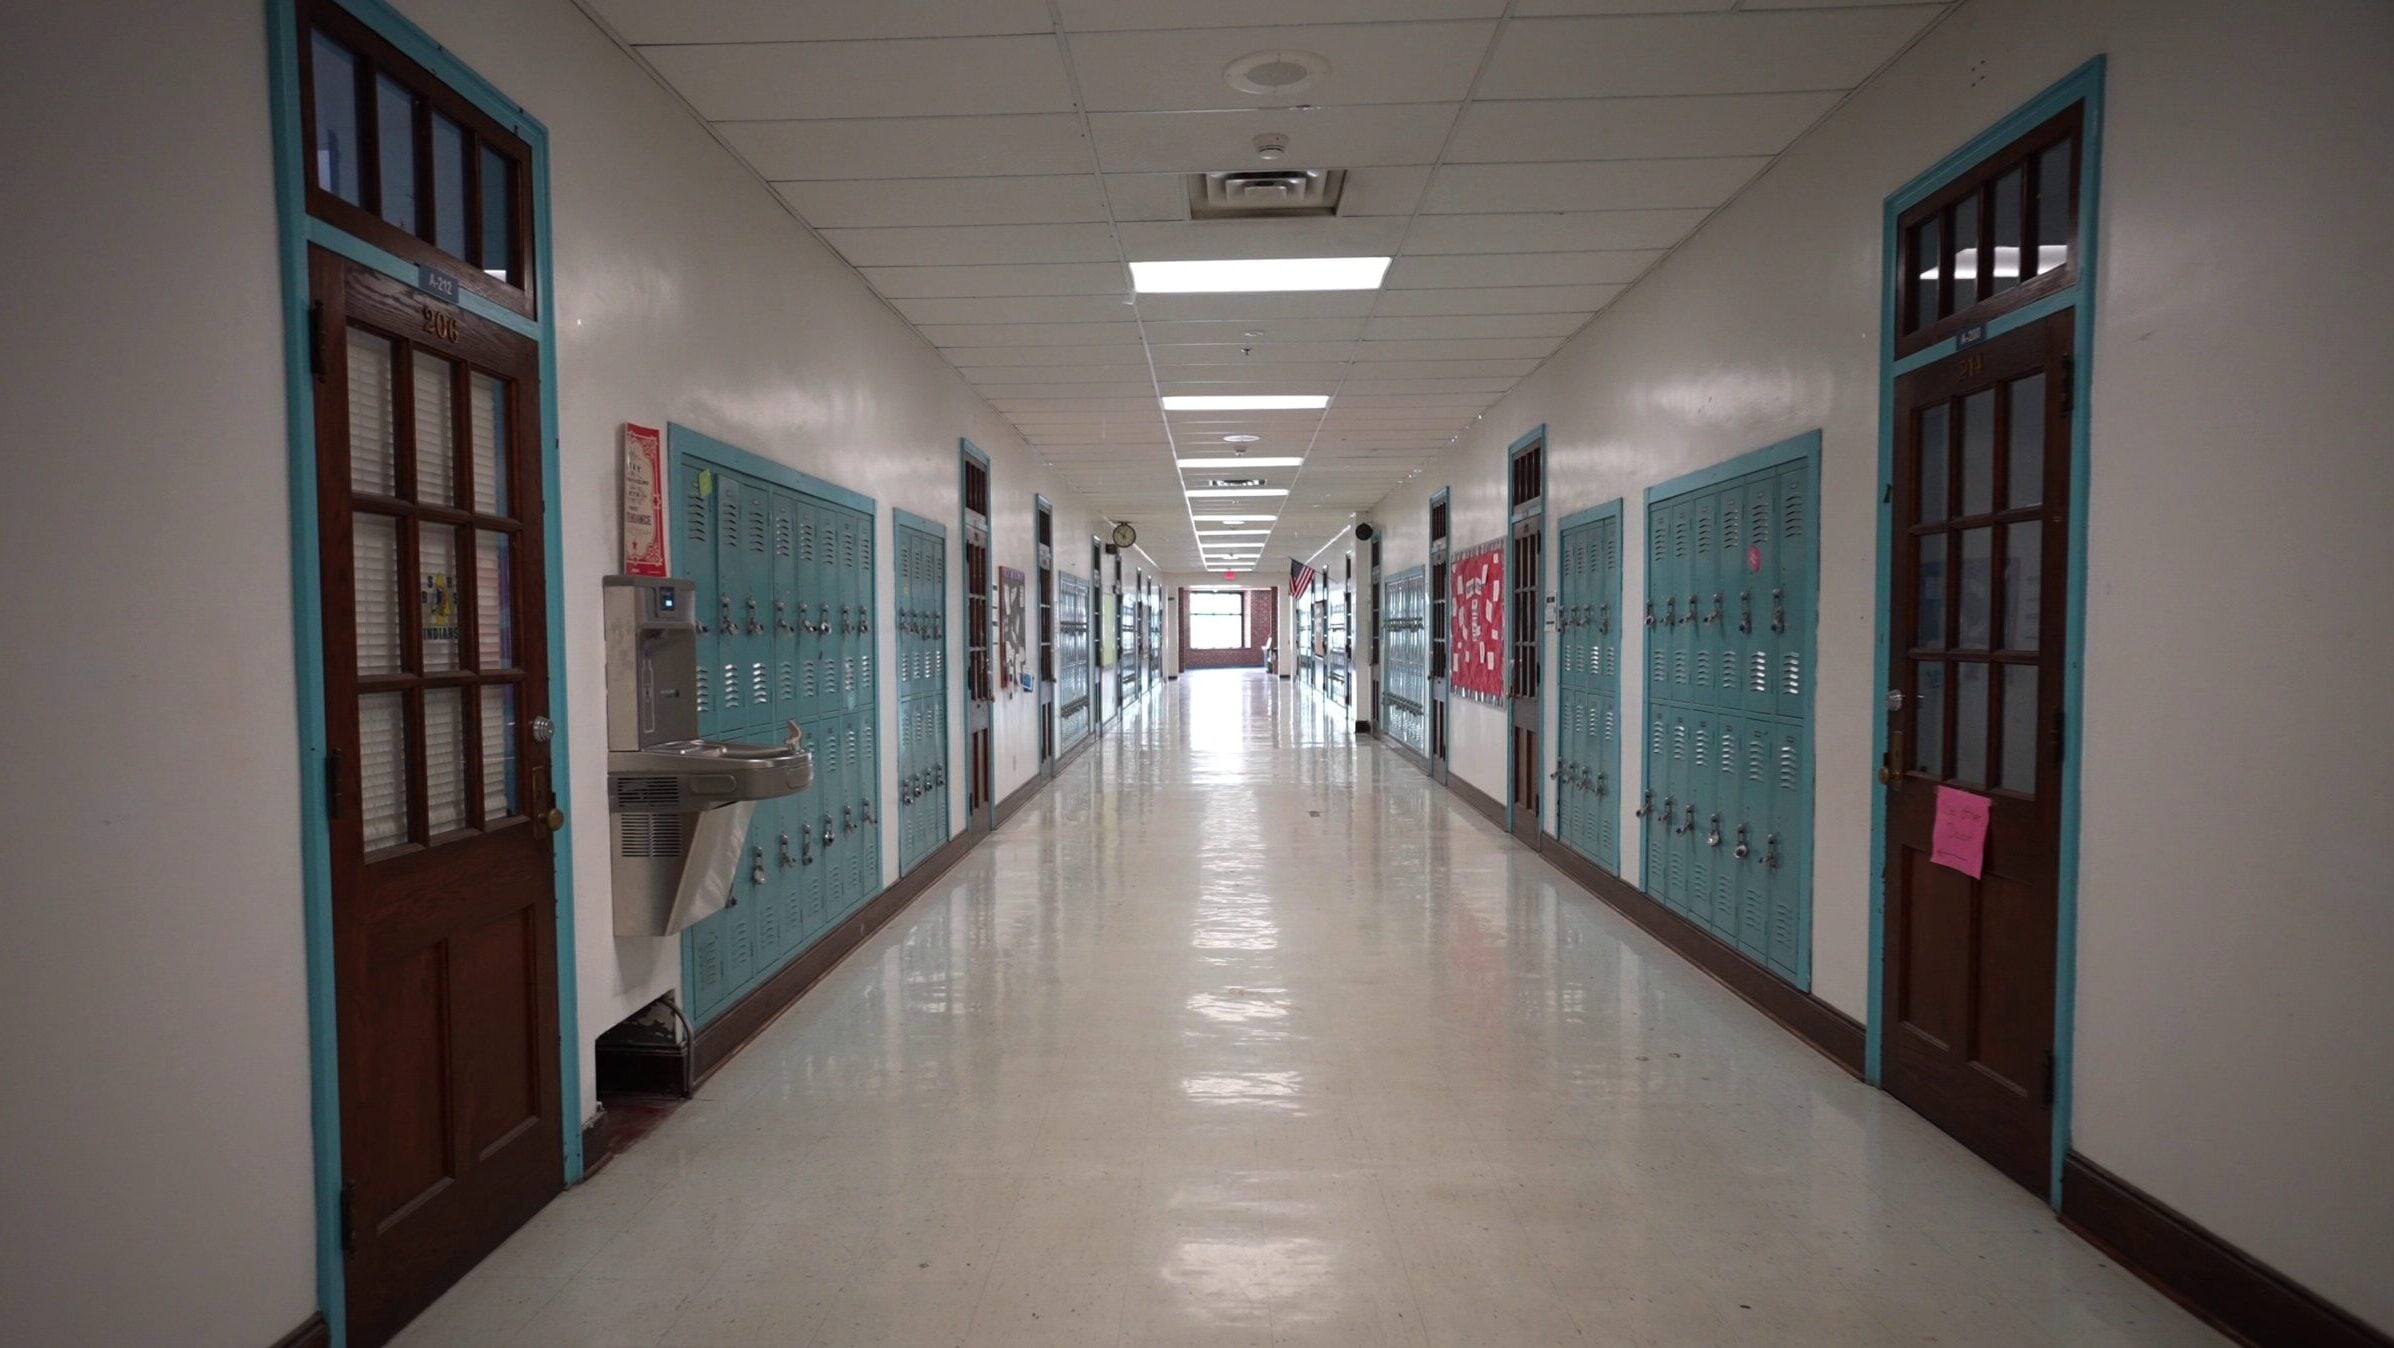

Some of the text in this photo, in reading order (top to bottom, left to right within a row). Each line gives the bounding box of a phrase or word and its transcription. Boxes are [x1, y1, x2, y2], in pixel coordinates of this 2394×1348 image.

[429, 273, 452, 295] A-212
[422, 305, 459, 344] 206
[423, 627, 459, 640] INDIANS
